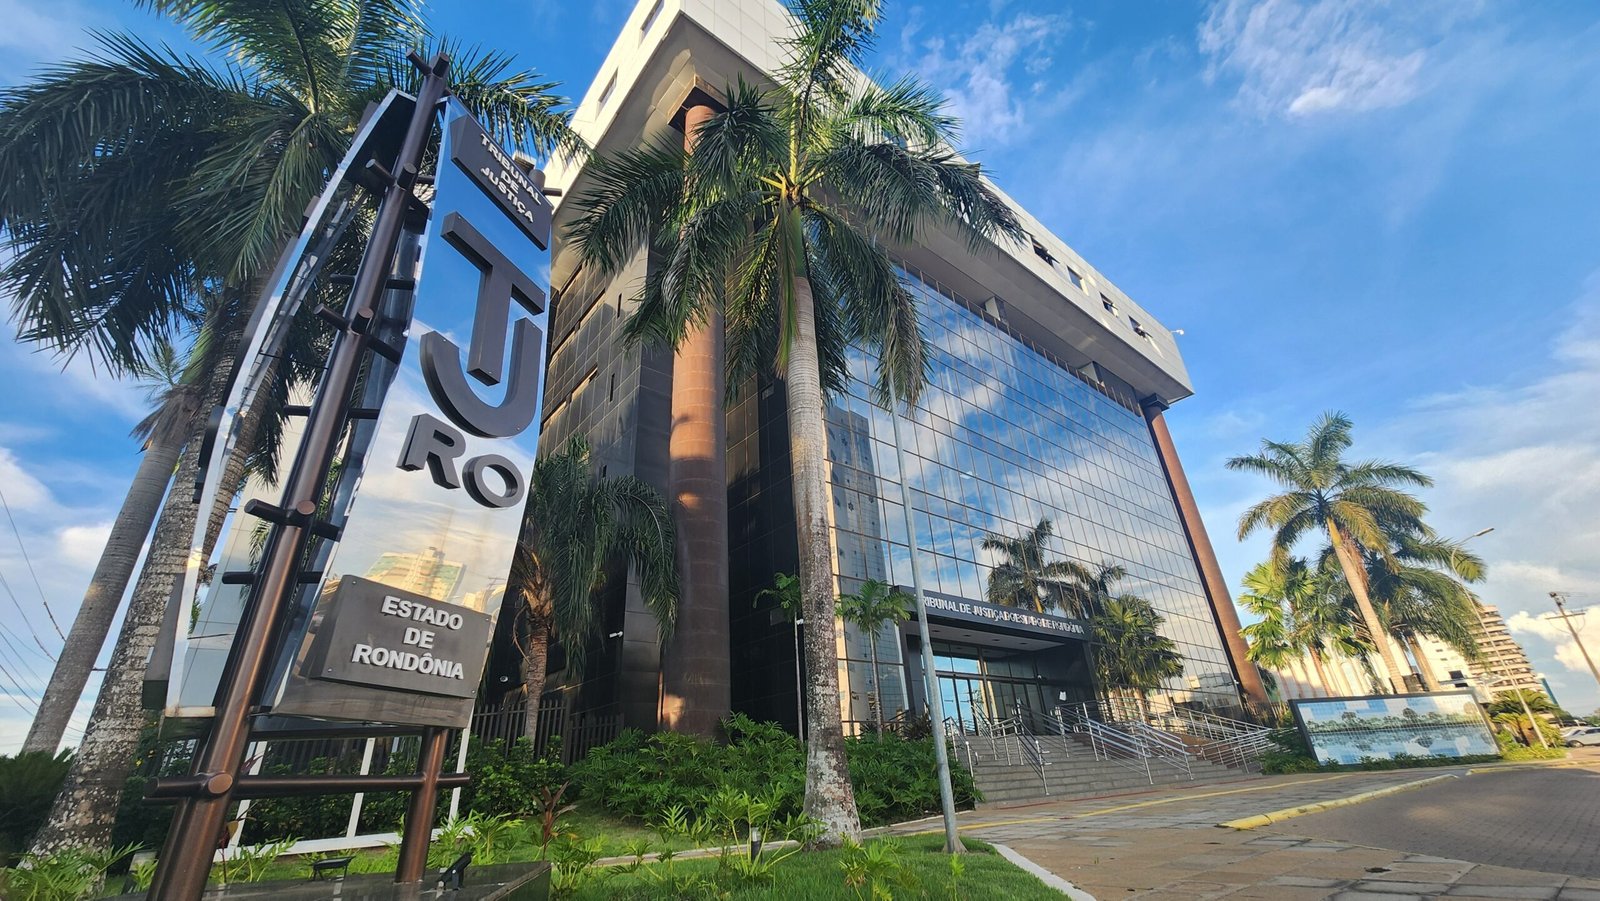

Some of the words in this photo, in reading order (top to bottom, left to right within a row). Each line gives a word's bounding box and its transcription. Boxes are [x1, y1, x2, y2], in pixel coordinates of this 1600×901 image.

[481, 133, 541, 205] TRIBUNAL
[501, 170, 520, 194] DE
[480, 167, 534, 223] JUSTIÇA
[396, 413, 525, 509] RO
[381, 595, 464, 631] ESTADO
[915, 594, 959, 612] RIBUNAL
[959, 603, 972, 614] DE
[973, 606, 1005, 621] JUSTIÇA
[403, 627, 436, 649] DE
[351, 643, 465, 680] RONDÔNIA
